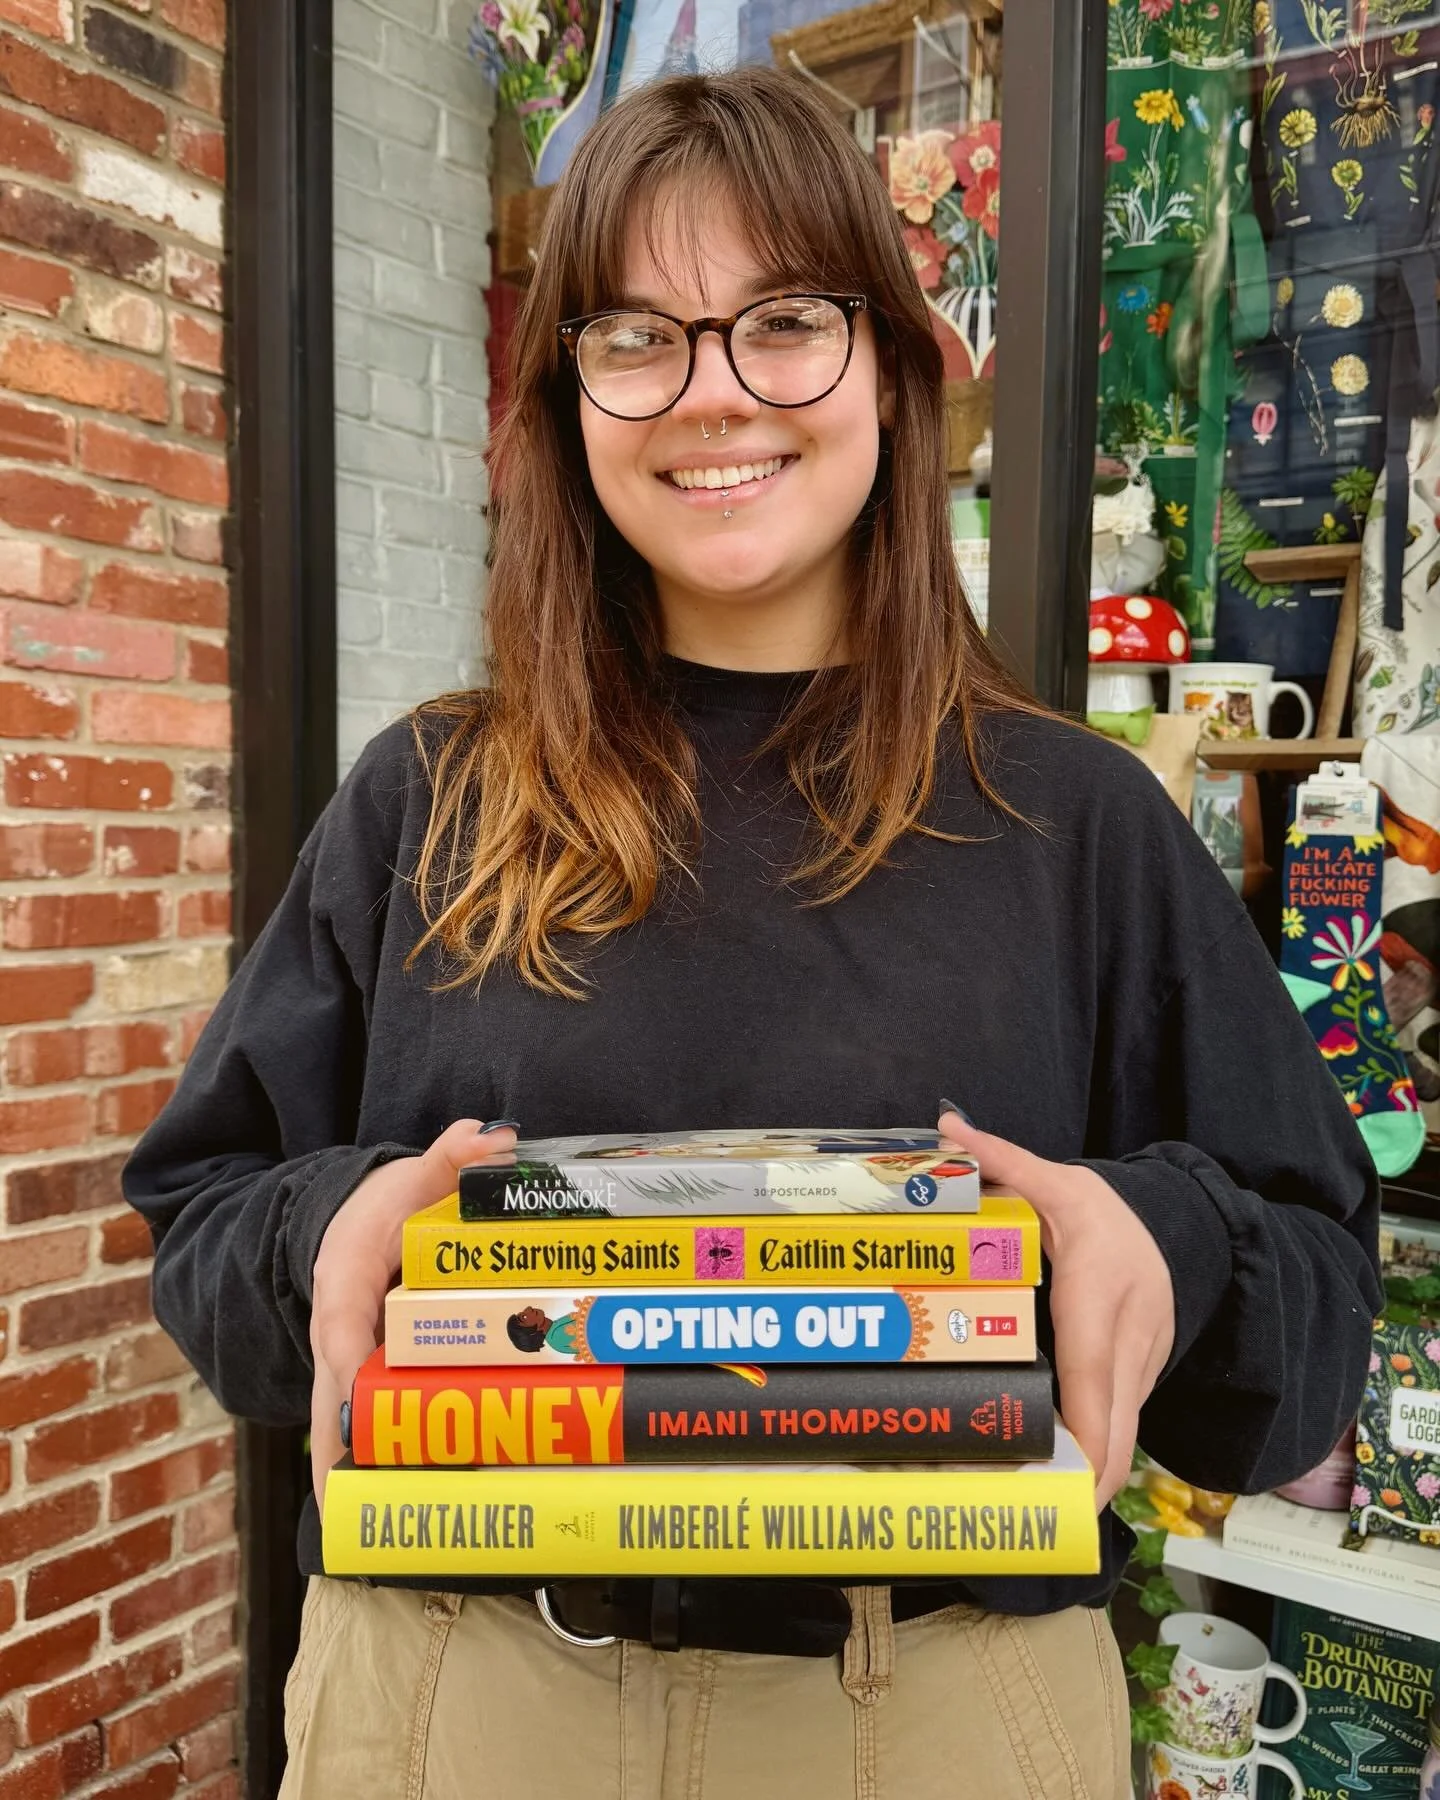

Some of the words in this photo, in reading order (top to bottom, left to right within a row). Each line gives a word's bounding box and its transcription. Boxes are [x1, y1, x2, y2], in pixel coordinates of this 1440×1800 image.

[1303, 847, 1330, 861] I'M
[1337, 846, 1353, 861] A
[1290, 862, 1376, 876] DELICATE
[1289, 877, 1370, 892] FUCKING
[1289, 891, 1366, 908] FLOWER
[753, 1187, 767, 1197] 30
[770, 1187, 837, 1197] POSTCARDS
[435, 1240, 482, 1274] The
[489, 1240, 597, 1275] Starving
[602, 1239, 680, 1270] Saints
[759, 1238, 845, 1272] Caitlin
[852, 1238, 956, 1275] Starling
[413, 1319, 468, 1330] KOBABE
[476, 1318, 486, 1330] &
[612, 1306, 781, 1351] OPTING
[795, 1305, 886, 1348] OUT
[413, 1333, 486, 1346] SRIKUMAR
[372, 1386, 624, 1466] HONEY
[648, 1410, 748, 1437] IMANI
[760, 1407, 951, 1436] THOMPSON
[1001, 1392, 1011, 1440] RANDOM
[1014, 1399, 1023, 1434] HOUSE
[360, 1504, 534, 1549] BACKTALKER
[618, 1497, 750, 1550] KIMBERLÉ
[761, 1504, 895, 1551] WILLIAMS
[906, 1505, 1058, 1552] CRENSHAW
[1301, 1631, 1434, 1688] DRUNKEN
[1297, 1657, 1436, 1719] BOTANIST
[1371, 1713, 1396, 1732] THAT
[1359, 1764, 1388, 1774] GREAT
